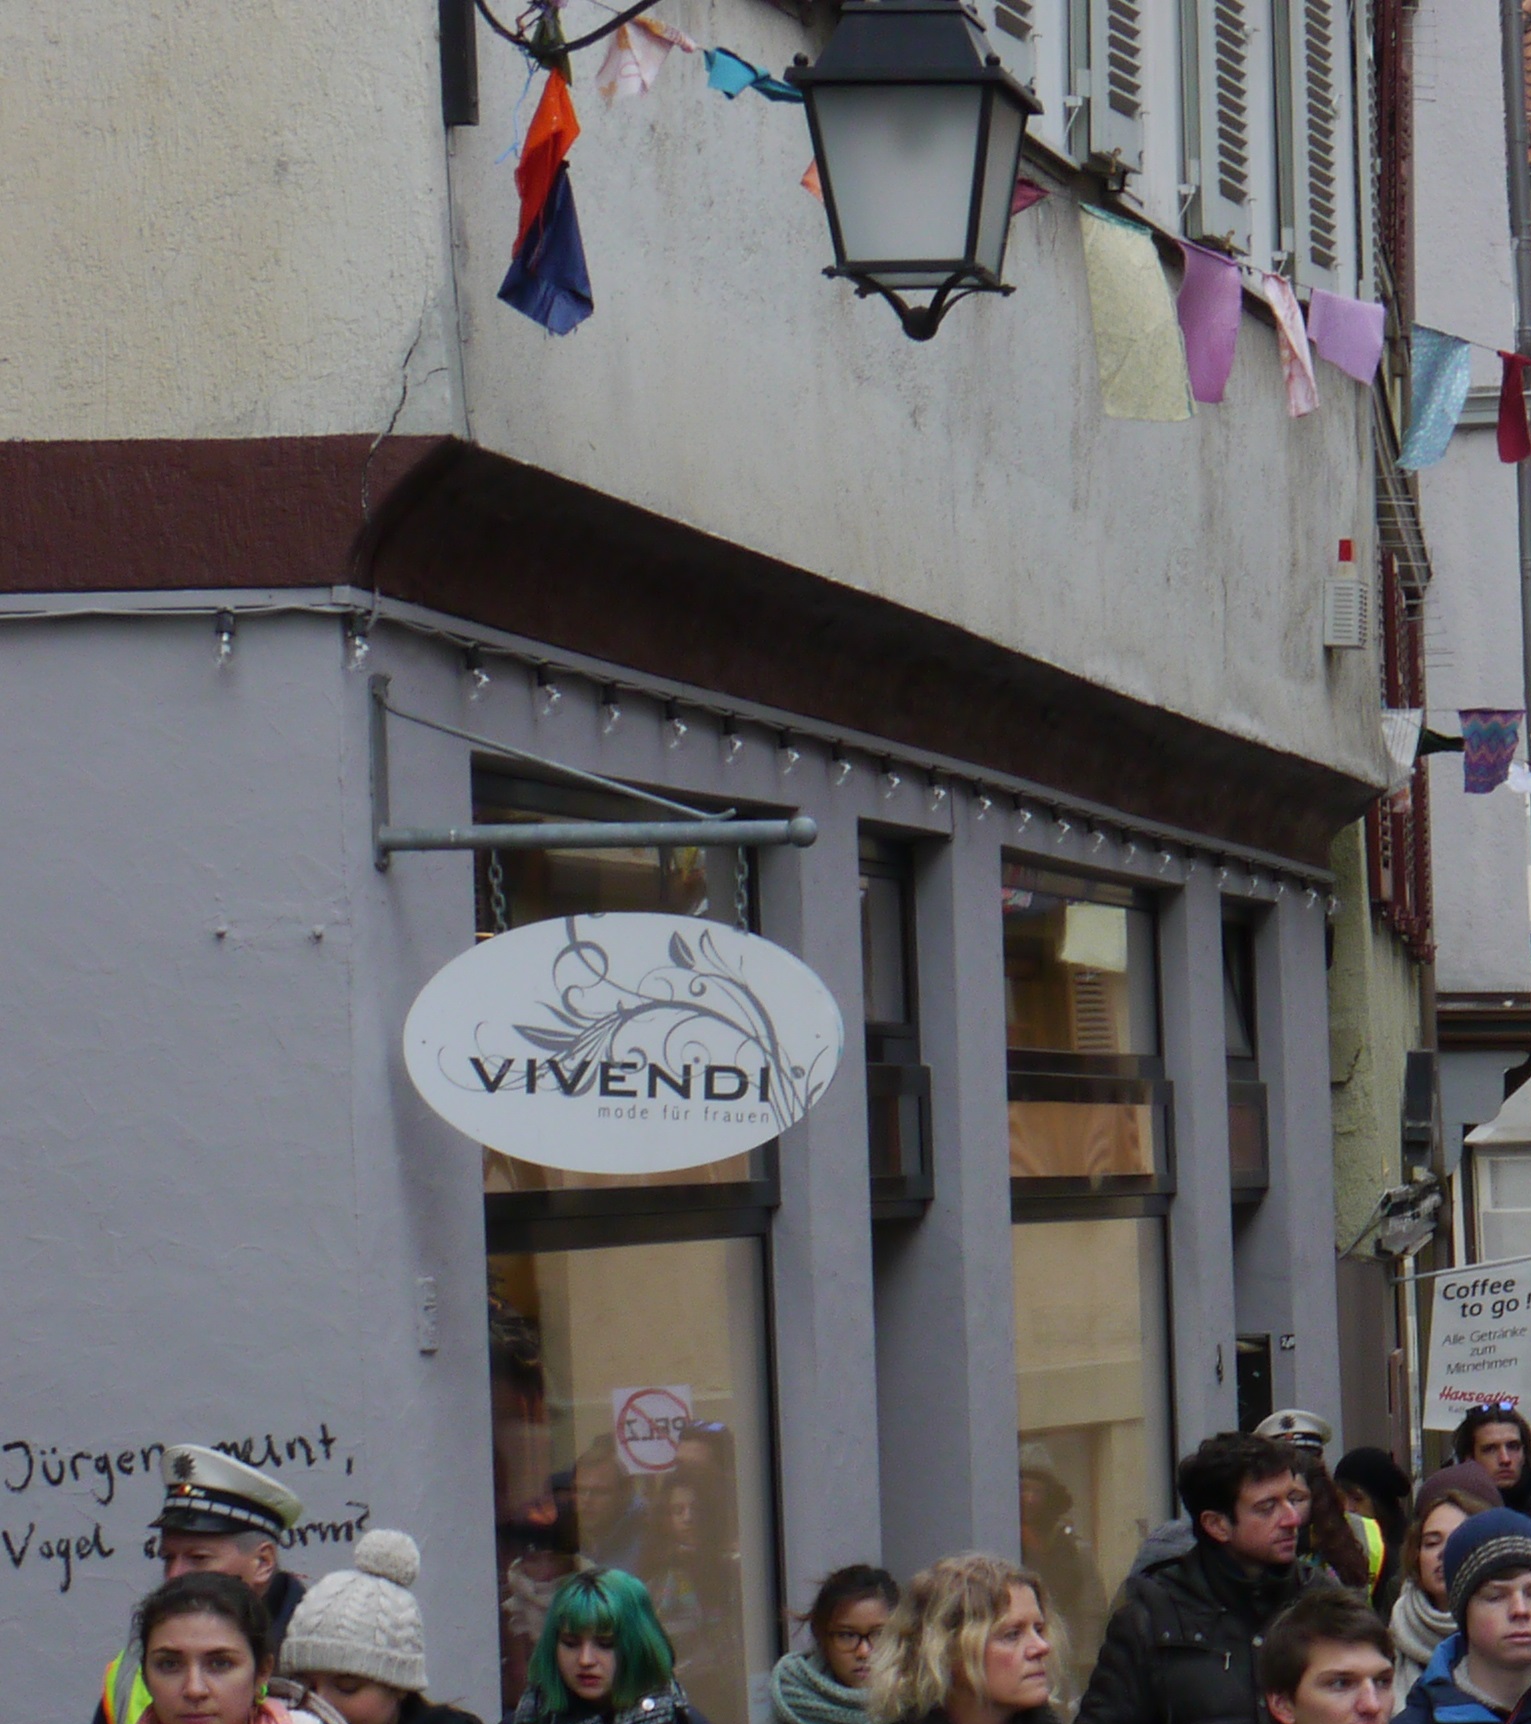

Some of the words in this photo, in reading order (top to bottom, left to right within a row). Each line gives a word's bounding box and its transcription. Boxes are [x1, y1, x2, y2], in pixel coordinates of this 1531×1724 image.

[469, 1057, 771, 1103] VIVENDI
[597, 1104, 650, 1121] mode
[662, 1104, 691, 1122] für
[703, 1106, 770, 1125] frauen
[1442, 1278, 1517, 1301] Coffee
[1460, 1302, 1483, 1318] to
[1491, 1298, 1520, 1319] go
[1442, 1332, 1466, 1347] Alle
[1470, 1325, 1528, 1343] Getränke
[1469, 1344, 1497, 1357] zum
[1445, 1356, 1518, 1375] Mitnehmen
[2, 1522, 115, 1593] Vogel
[278, 1501, 371, 1550] urm?
